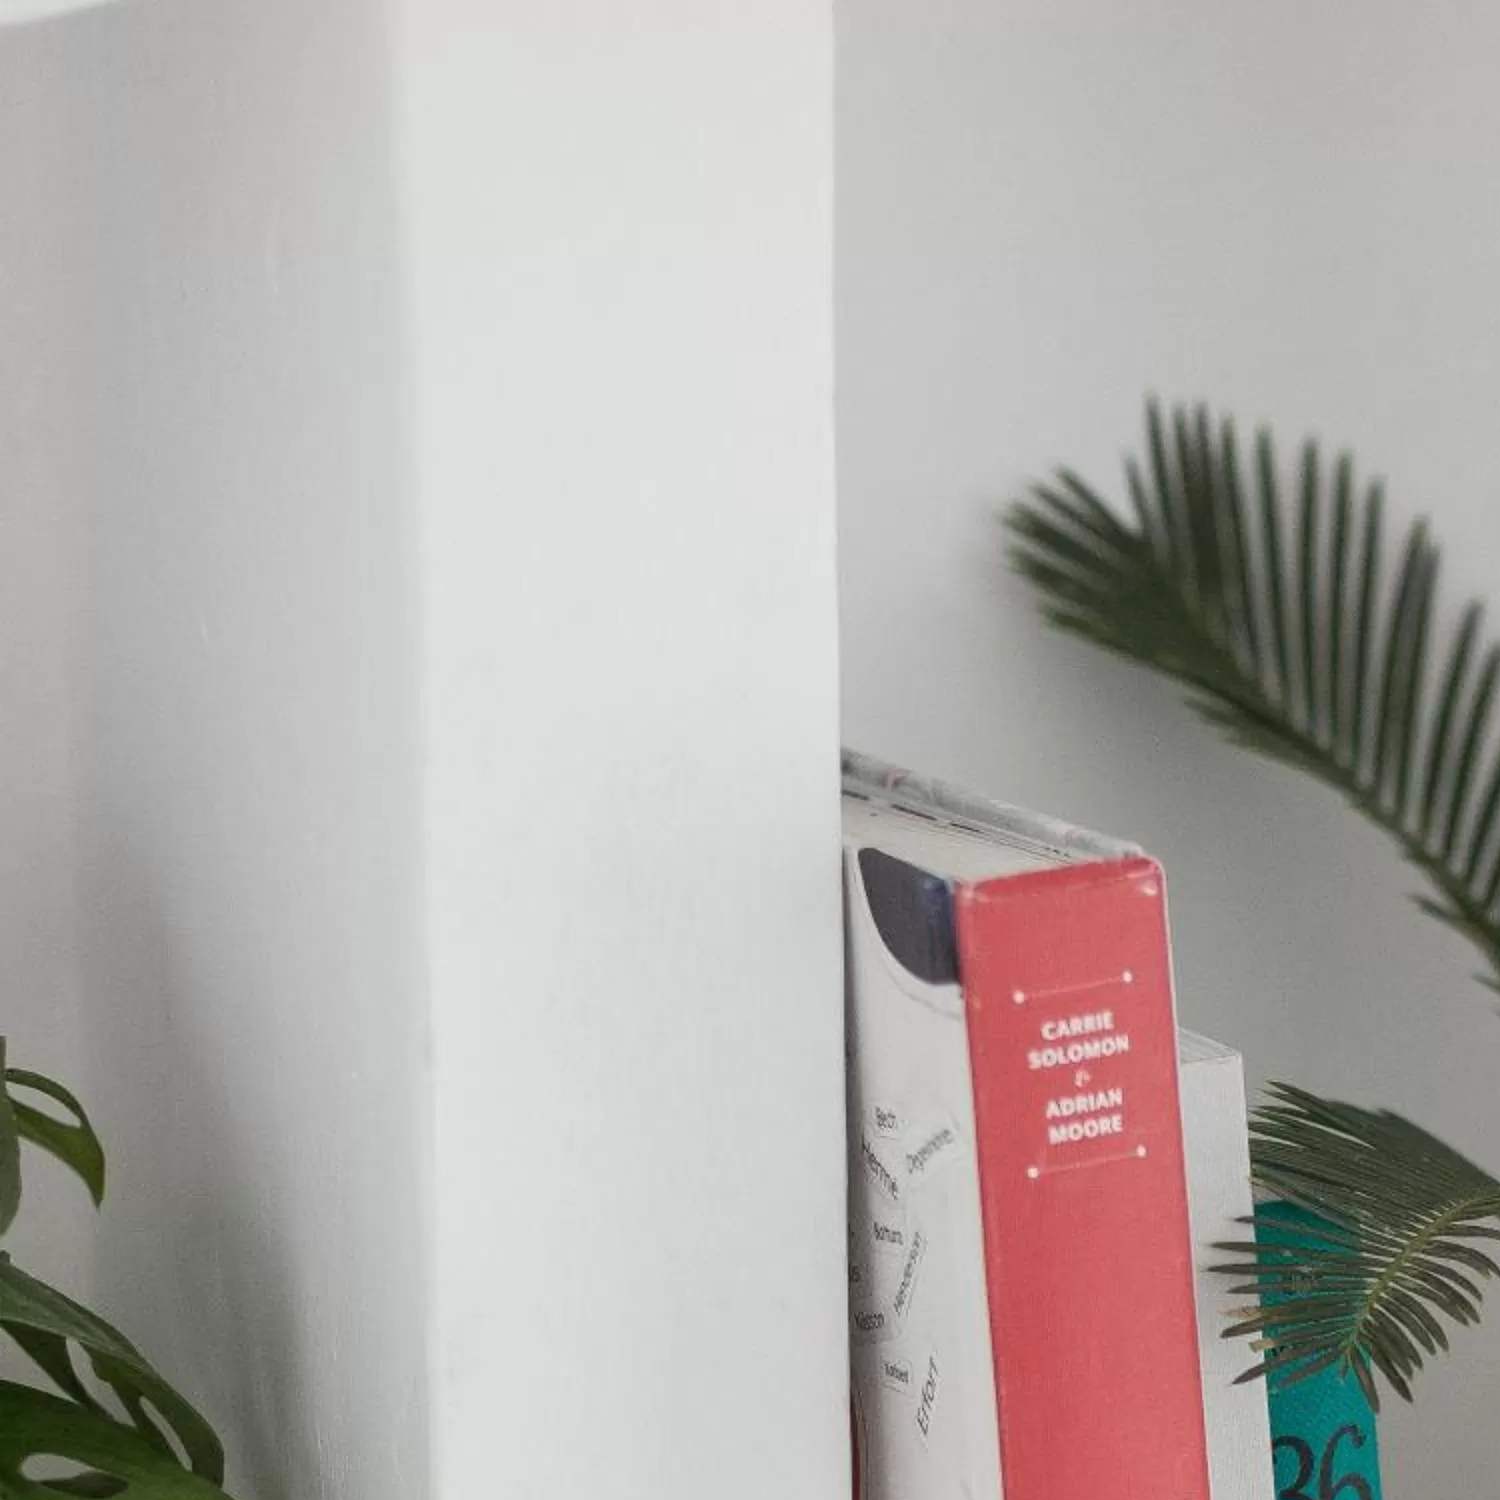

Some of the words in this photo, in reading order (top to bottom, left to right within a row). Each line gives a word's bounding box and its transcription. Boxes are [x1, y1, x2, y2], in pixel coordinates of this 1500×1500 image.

[1041, 1011, 1114, 1041] CARRIE
[1027, 1035, 1129, 1070] SOLOMON
[1046, 1088, 1123, 1118] ADRIAN
[1049, 1115, 1123, 1144] MOORE
